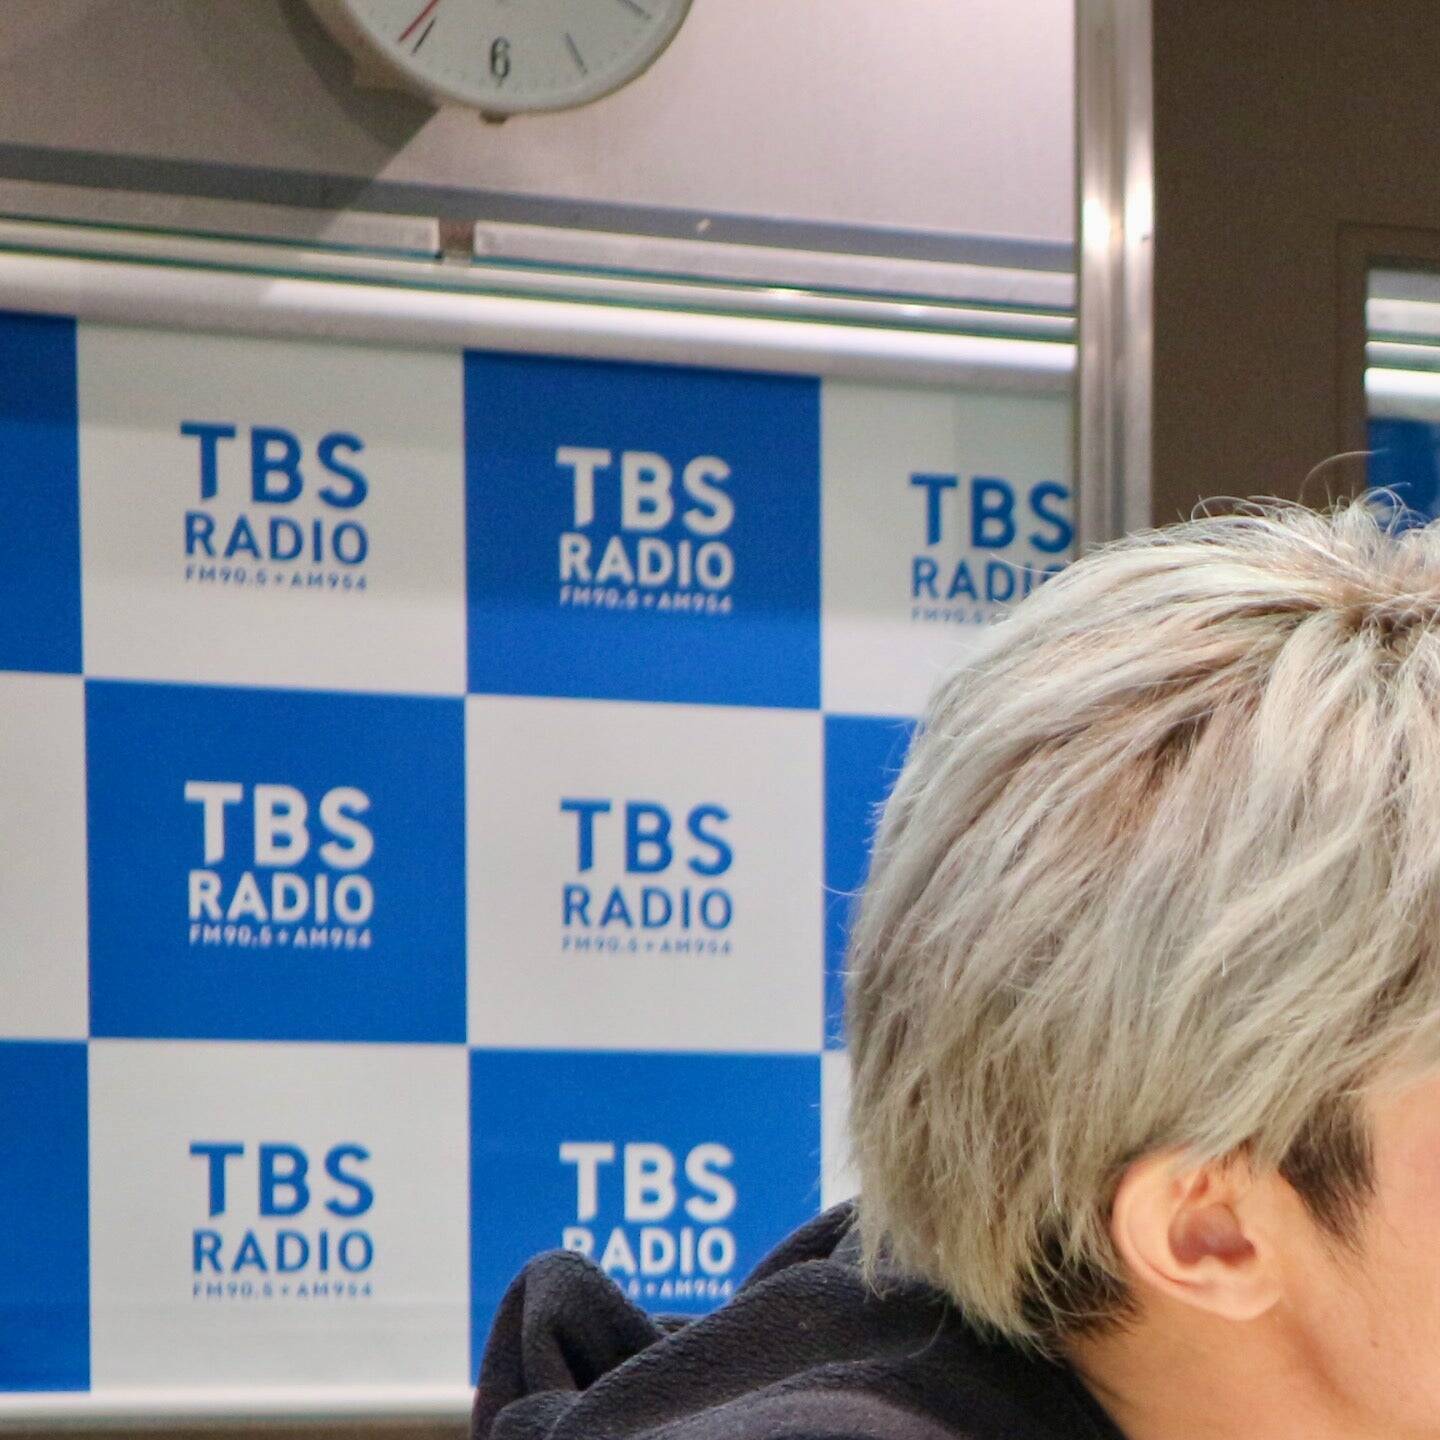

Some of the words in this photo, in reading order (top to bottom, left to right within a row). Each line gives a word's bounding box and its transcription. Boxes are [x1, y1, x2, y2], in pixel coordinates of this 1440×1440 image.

[489, 36, 510, 80] 6
[180, 420, 368, 509] TBS
[556, 446, 735, 536] TBS
[184, 511, 368, 566] RADIO
[910, 473, 1076, 554] TBS
[560, 532, 734, 590] RADIO
[912, 557, 1065, 602] RADI
[184, 780, 374, 869] TBS
[560, 797, 733, 877] TBS
[188, 869, 374, 925] RADIO
[563, 883, 733, 930] RADIO
[190, 1141, 374, 1218] TBS
[559, 1142, 737, 1223] TBS
[192, 1227, 374, 1273] RADIO
